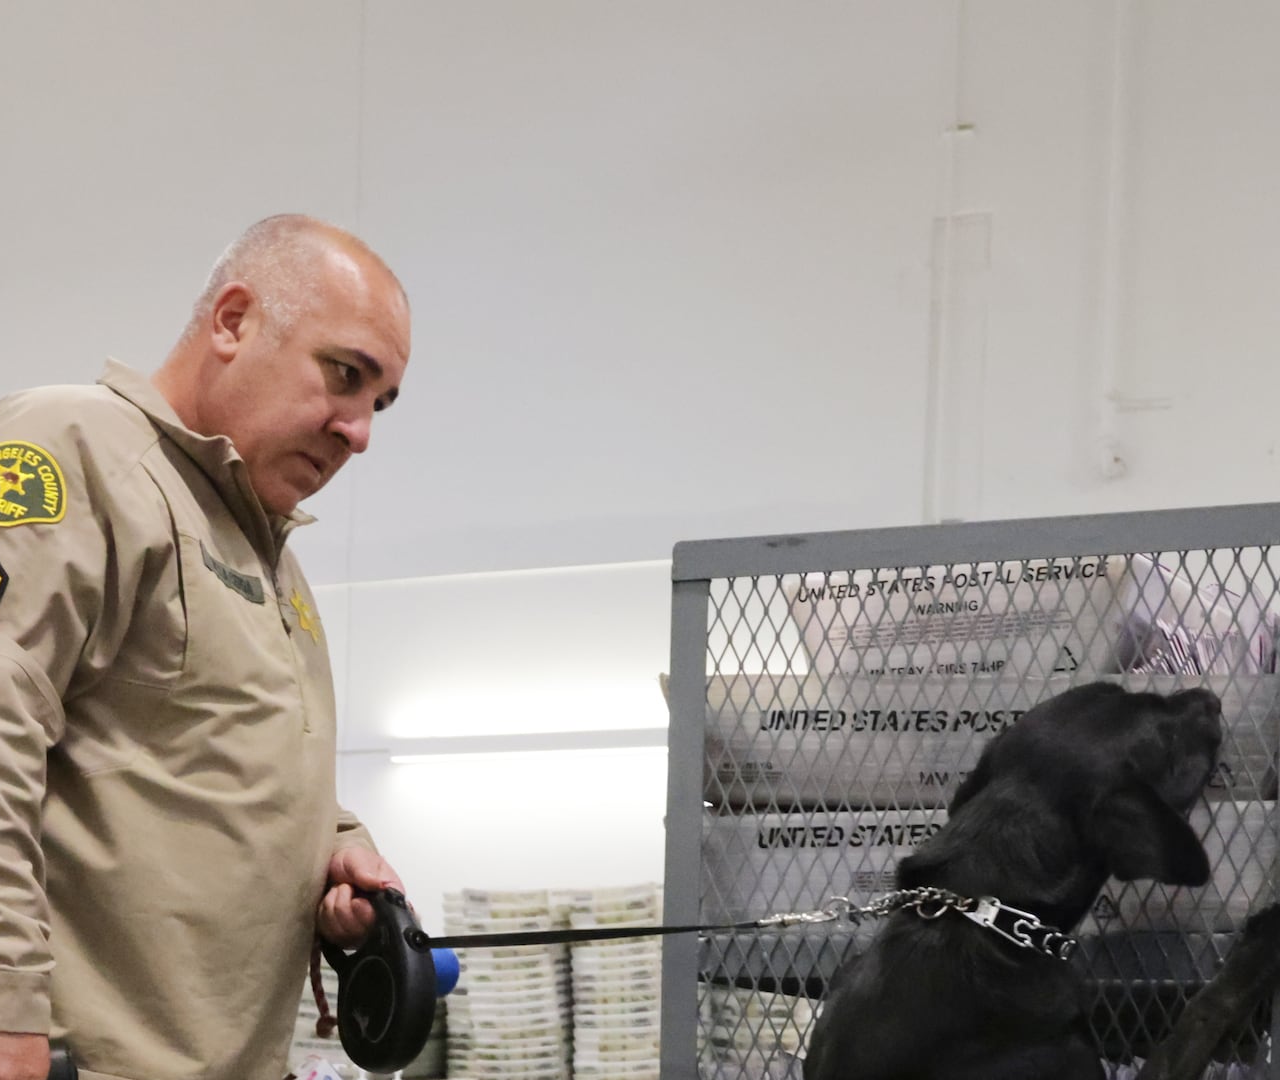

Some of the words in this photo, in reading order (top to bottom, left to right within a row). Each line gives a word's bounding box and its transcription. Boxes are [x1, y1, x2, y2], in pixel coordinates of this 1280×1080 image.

[38, 465, 59, 515] COUNTY
[798, 585, 860, 603] UNITED
[866, 576, 935, 596] STATES
[945, 570, 1015, 589] OSTL
[761, 710, 846, 731] UNITED
[852, 710, 948, 732] STATES
[952, 710, 1028, 732] POST
[757, 827, 844, 848] UNITED
